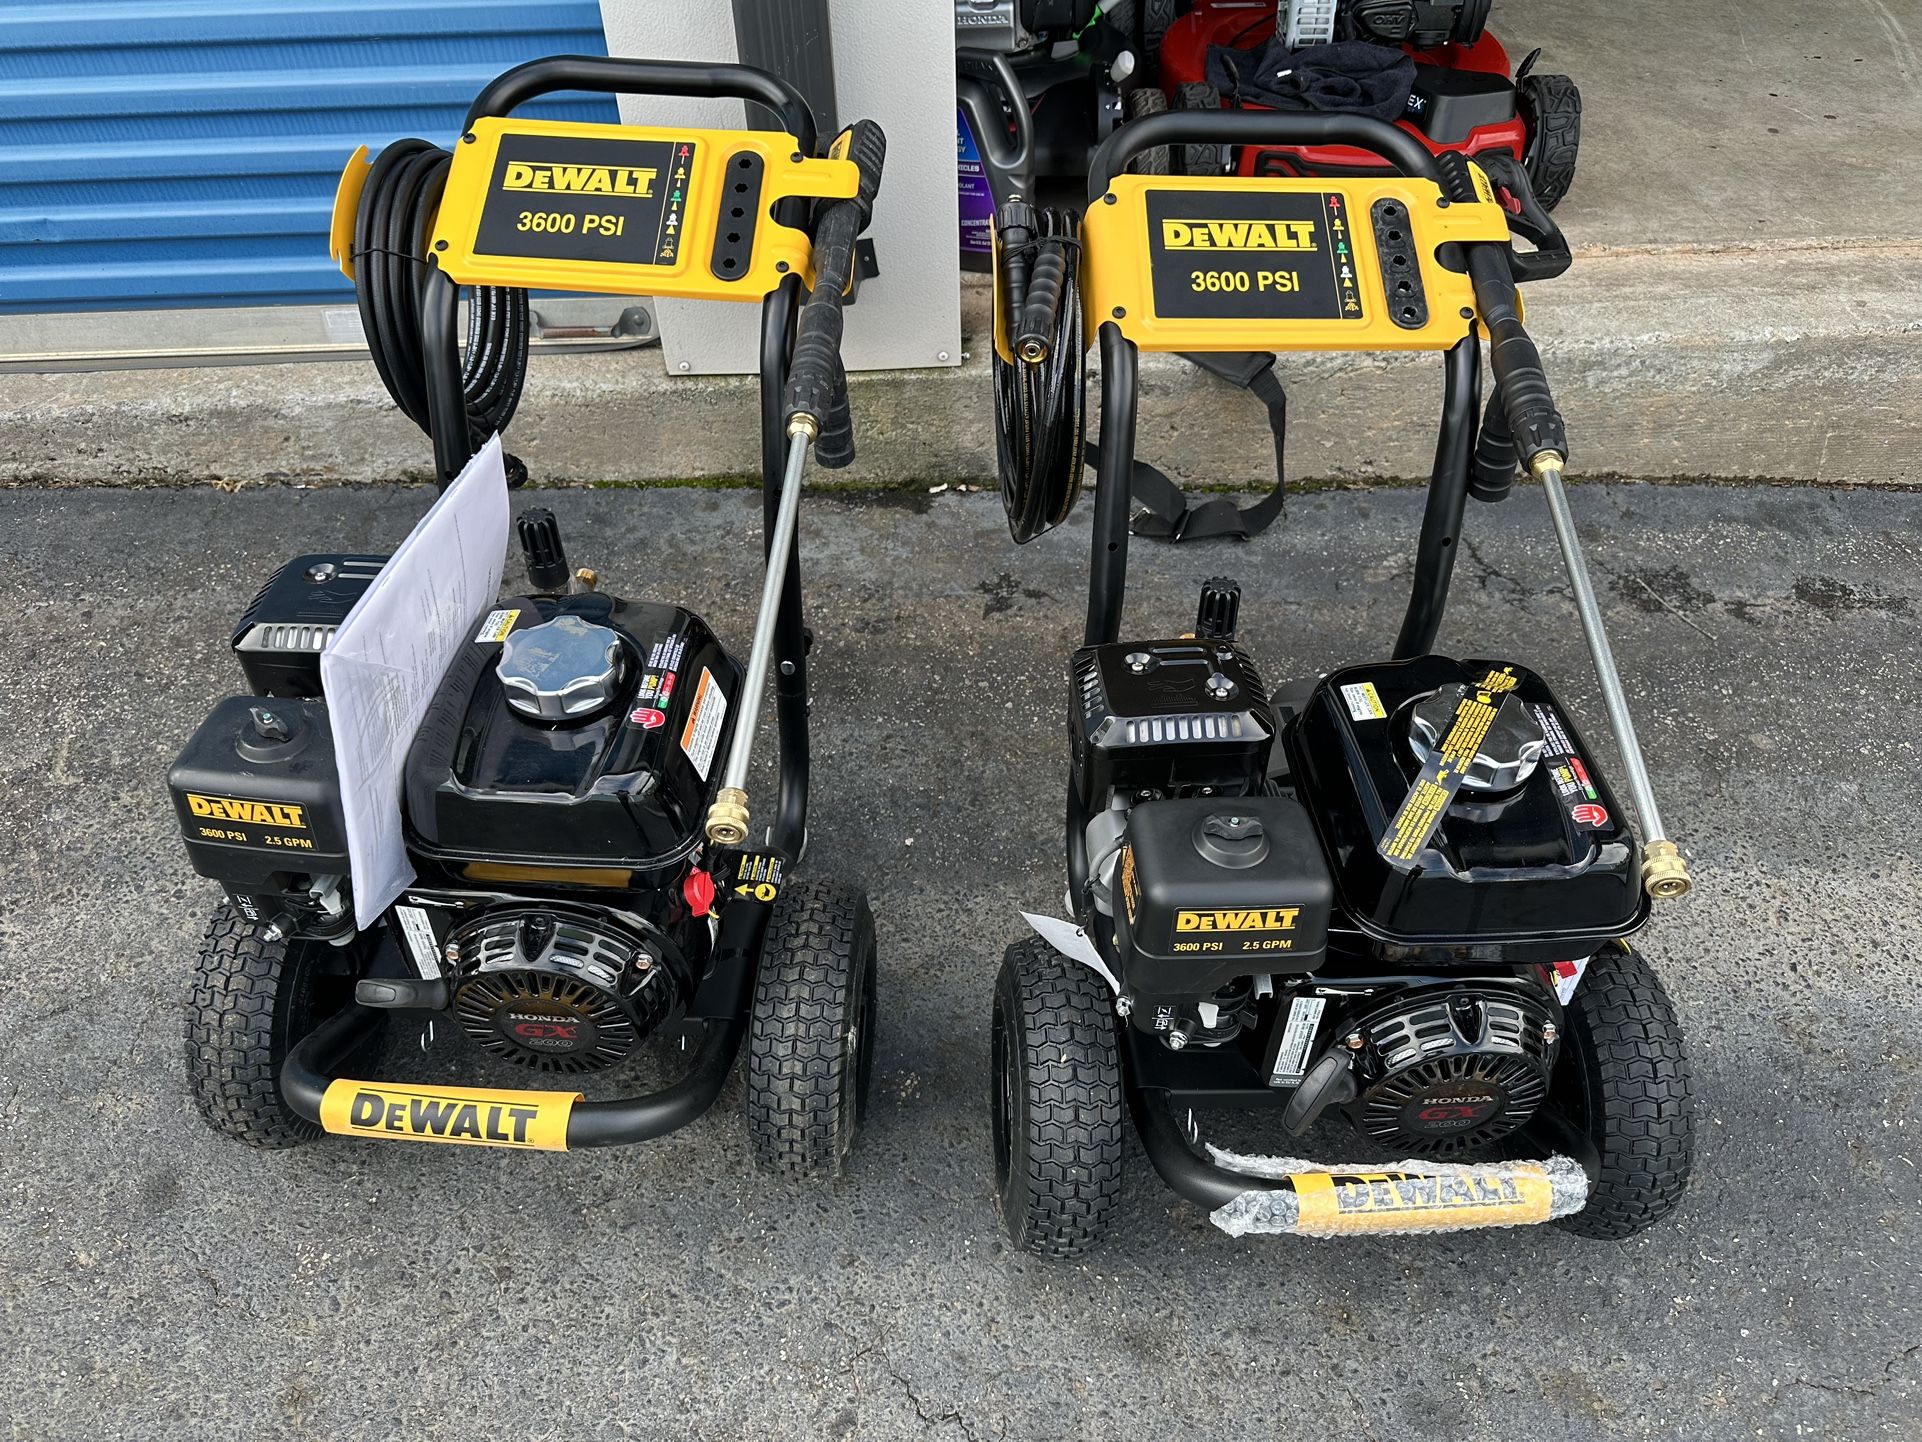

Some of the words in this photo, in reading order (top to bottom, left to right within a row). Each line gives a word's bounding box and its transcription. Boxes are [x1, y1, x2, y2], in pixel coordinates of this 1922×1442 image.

[957, 16, 1008, 25] HONDA
[503, 164, 656, 194] DEWALT
[516, 212, 576, 234] 3600
[582, 214, 624, 236] PSI
[1162, 222, 1314, 248] DEWALT
[1190, 271, 1250, 292] 3600
[1257, 271, 1300, 292] PSI
[188, 796, 302, 826] DEWALT
[200, 828, 224, 838] 3600
[226, 830, 248, 842] PSI
[264, 836, 282, 845] 2.5
[284, 838, 312, 848] GPM
[1176, 910, 1299, 930] DEWALT
[1173, 943, 1200, 952] 3600
[1202, 942, 1224, 950] PSI
[1242, 941, 1260, 950] 2.5
[1262, 940, 1292, 949] GPM
[508, 1012, 580, 1022] HONDA
[514, 1024, 578, 1039] GX
[529, 1038, 573, 1048] 200
[1422, 1096, 1494, 1104] HONDA
[350, 1092, 538, 1142] DEWALT
[1418, 1104, 1488, 1120] GX
[1331, 1176, 1518, 1210] DEWALT
